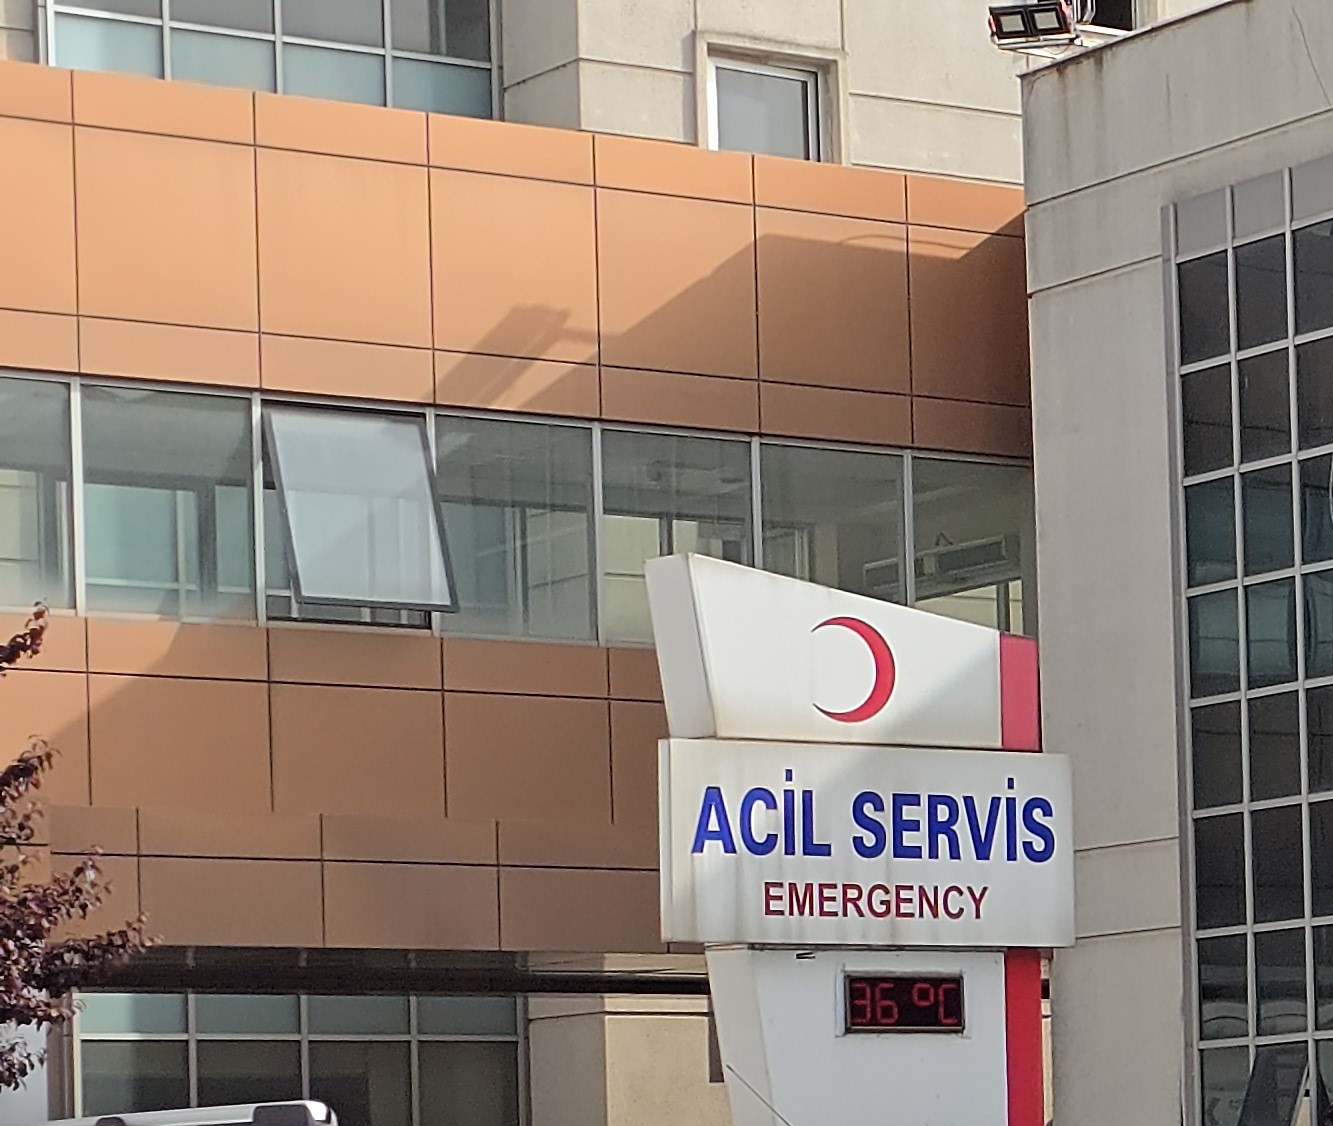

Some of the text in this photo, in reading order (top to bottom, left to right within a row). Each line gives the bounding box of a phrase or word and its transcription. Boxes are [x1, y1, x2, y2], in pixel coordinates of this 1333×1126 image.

[692, 769, 1055, 863] ACİL SERVİS
[764, 881, 988, 920] EMERGENCY
[851, 982, 899, 1025] 36
